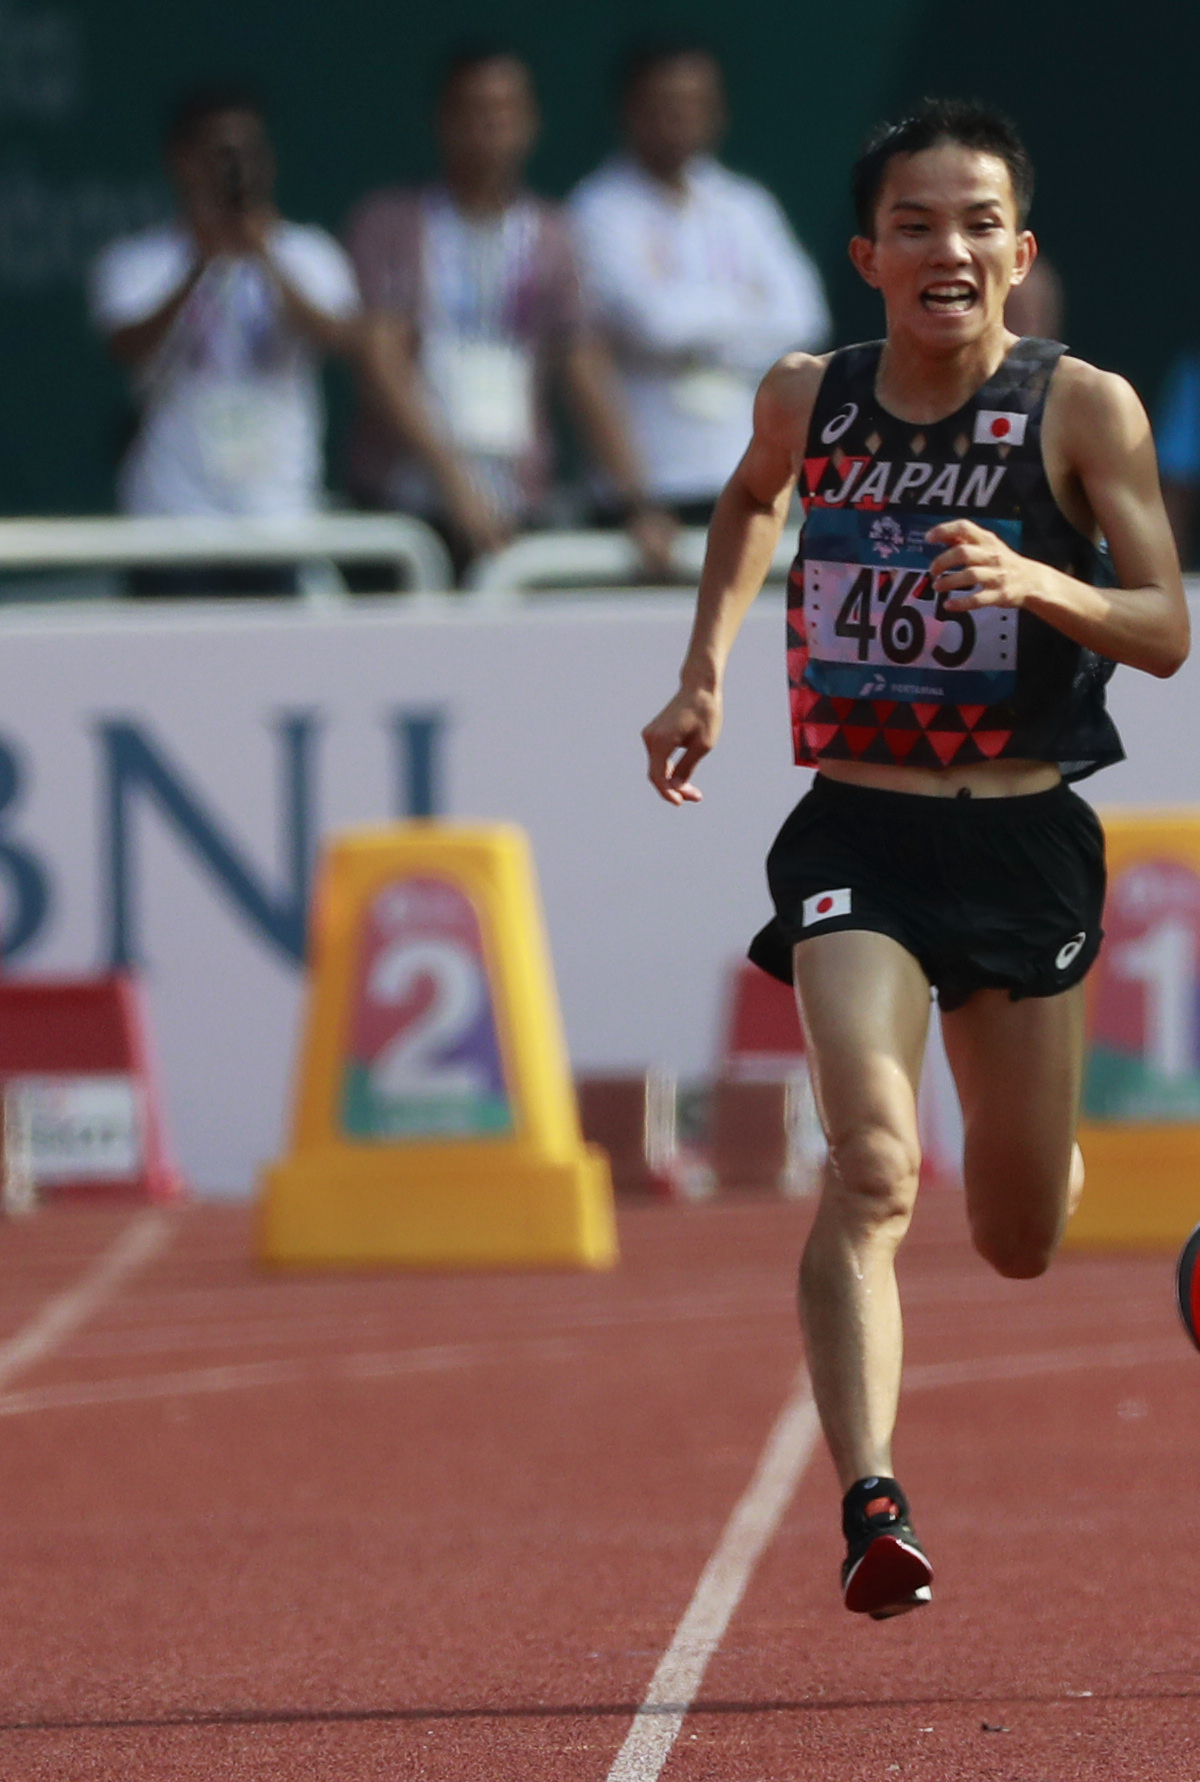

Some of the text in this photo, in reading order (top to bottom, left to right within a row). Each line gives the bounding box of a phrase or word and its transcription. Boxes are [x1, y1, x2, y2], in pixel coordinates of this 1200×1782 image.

[824, 461, 1007, 507] JAPAN
[834, 567, 976, 668] 465
[365, 938, 485, 1097] 2
[1108, 920, 1196, 1076] 1
